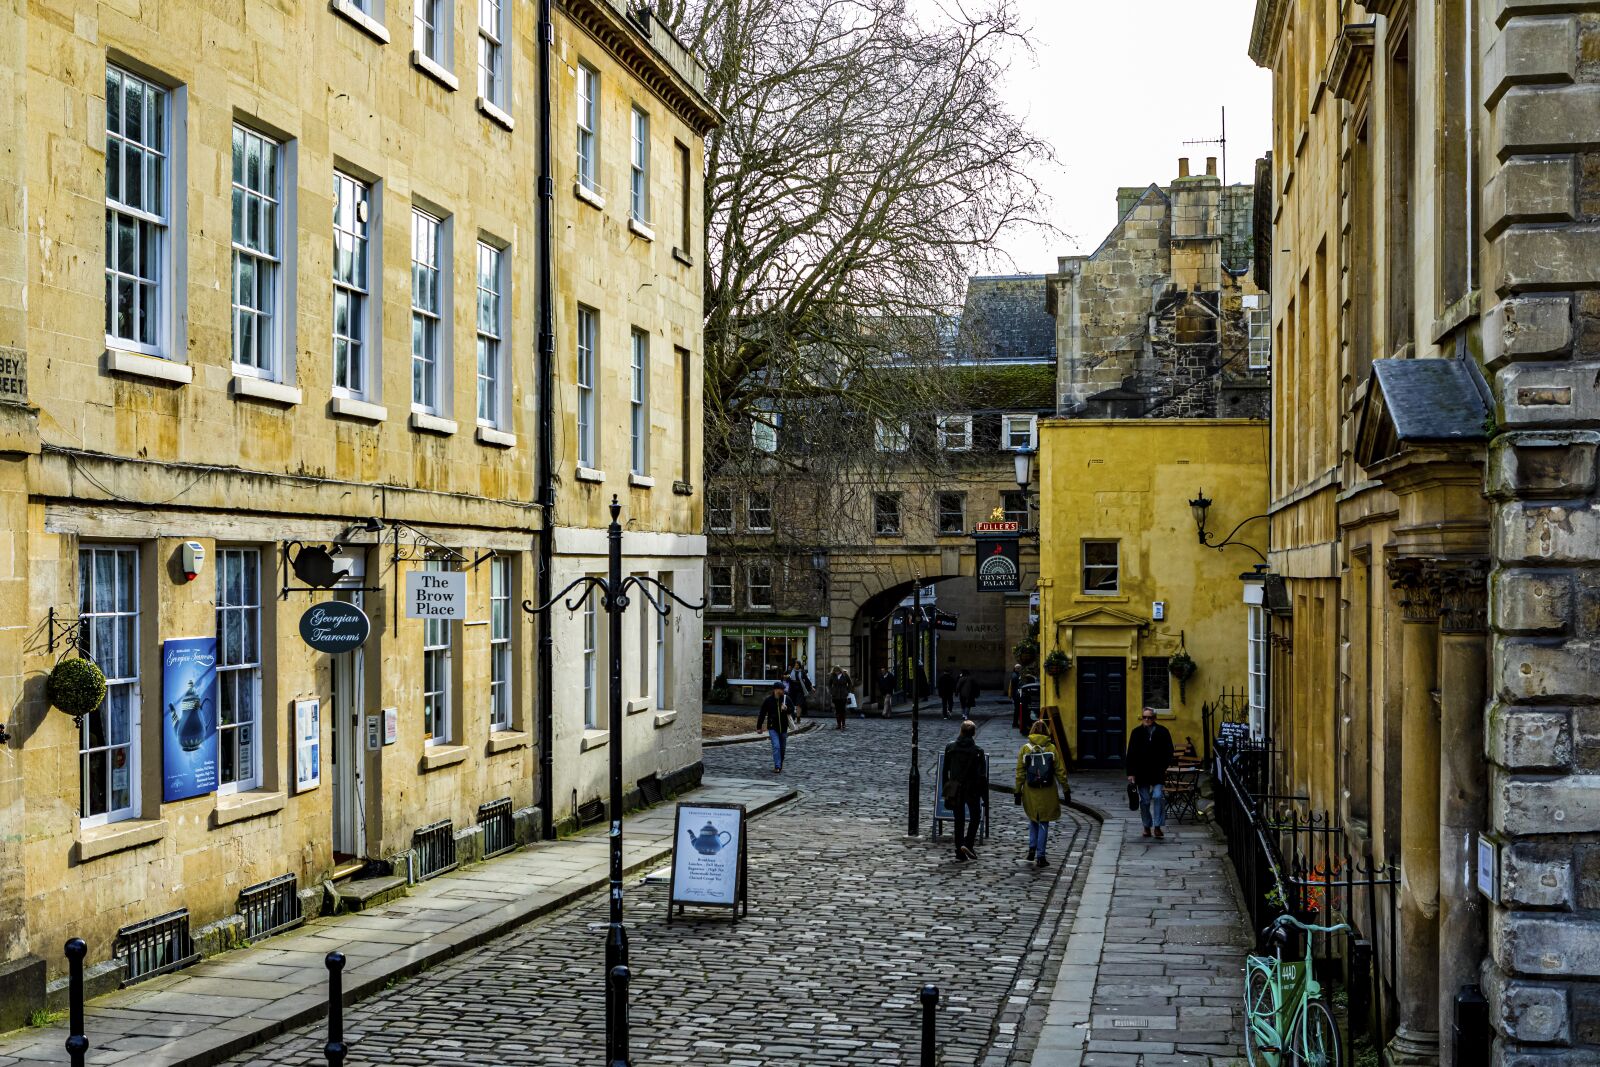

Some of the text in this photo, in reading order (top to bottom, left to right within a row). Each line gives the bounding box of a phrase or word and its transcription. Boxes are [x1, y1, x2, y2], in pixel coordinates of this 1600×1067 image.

[0, 377, 23, 395] EET
[421, 575, 449, 588] The
[416, 588, 454, 602] Brow
[416, 602, 454, 615] Place
[310, 608, 359, 628] Georgian
[310, 627, 360, 642] Tearooms
